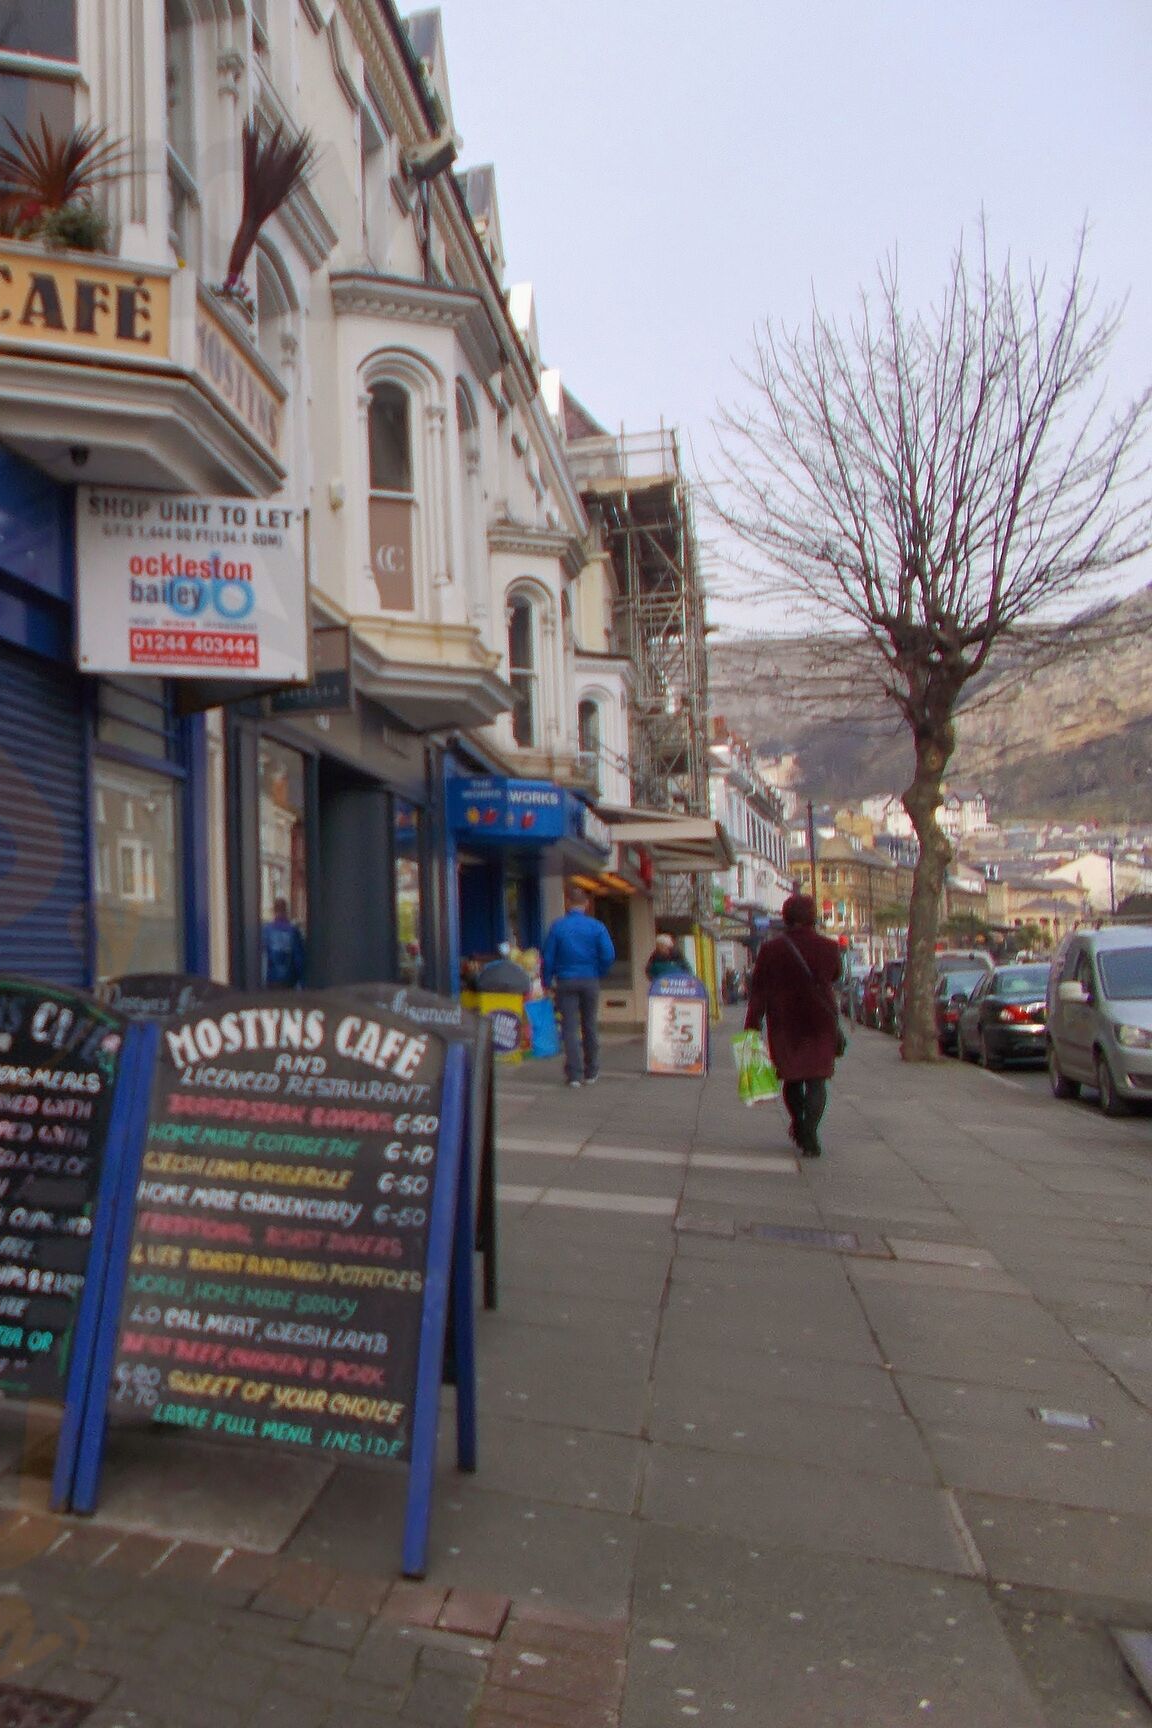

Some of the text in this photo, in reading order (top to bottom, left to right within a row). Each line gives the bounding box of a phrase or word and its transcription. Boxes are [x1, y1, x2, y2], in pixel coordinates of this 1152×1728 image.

[88, 496, 293, 529] SHOP UNIT TO LET
[130, 552, 253, 582] ockleston
[130, 579, 205, 611] bailey
[133, 634, 187, 652] 01244
[508, 789, 560, 806] WORKS
[166, 1008, 325, 1069] MOSTYNS
[335, 1015, 430, 1080] CAFÉ
[275, 1053, 327, 1075] AND
[180, 1067, 280, 1094] LICENCED
[137, 1180, 191, 1204] HOME
[188, 1187, 239, 1211] MADE
[327, 1262, 423, 1293] POTATOES
[330, 1328, 389, 1354] LAMB
[167, 1369, 242, 1398] SWEET
[241, 1380, 273, 1403] OF
[269, 1386, 328, 1412] YOUR
[328, 1392, 405, 1424] CHOICE
[212, 1411, 256, 1437] FULL
[260, 1420, 313, 1445] MENU
[321, 1430, 405, 1457] INSIDE
